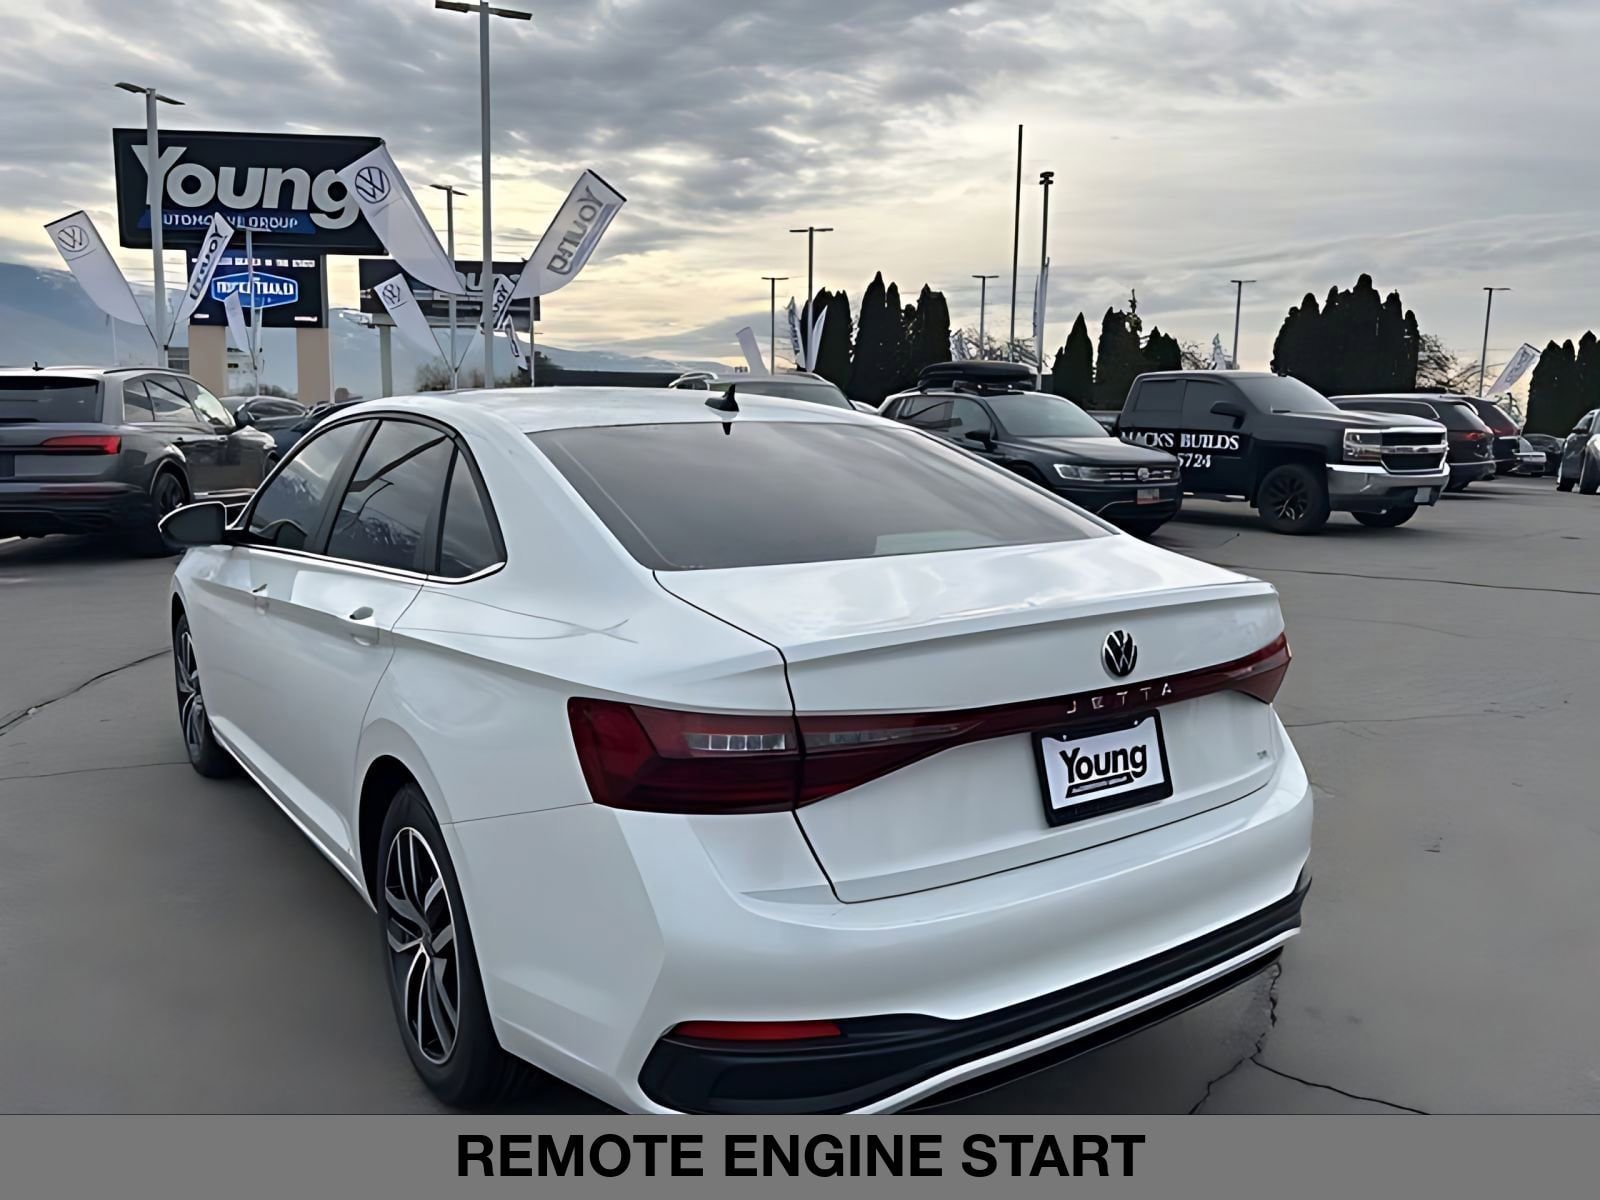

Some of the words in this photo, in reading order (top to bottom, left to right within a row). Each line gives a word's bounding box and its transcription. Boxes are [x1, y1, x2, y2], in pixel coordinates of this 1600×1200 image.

[131, 144, 360, 230] Young
[1180, 433, 1240, 450] BUILDS
[1066, 683, 1172, 714] JETTA
[1059, 744, 1147, 784] Young
